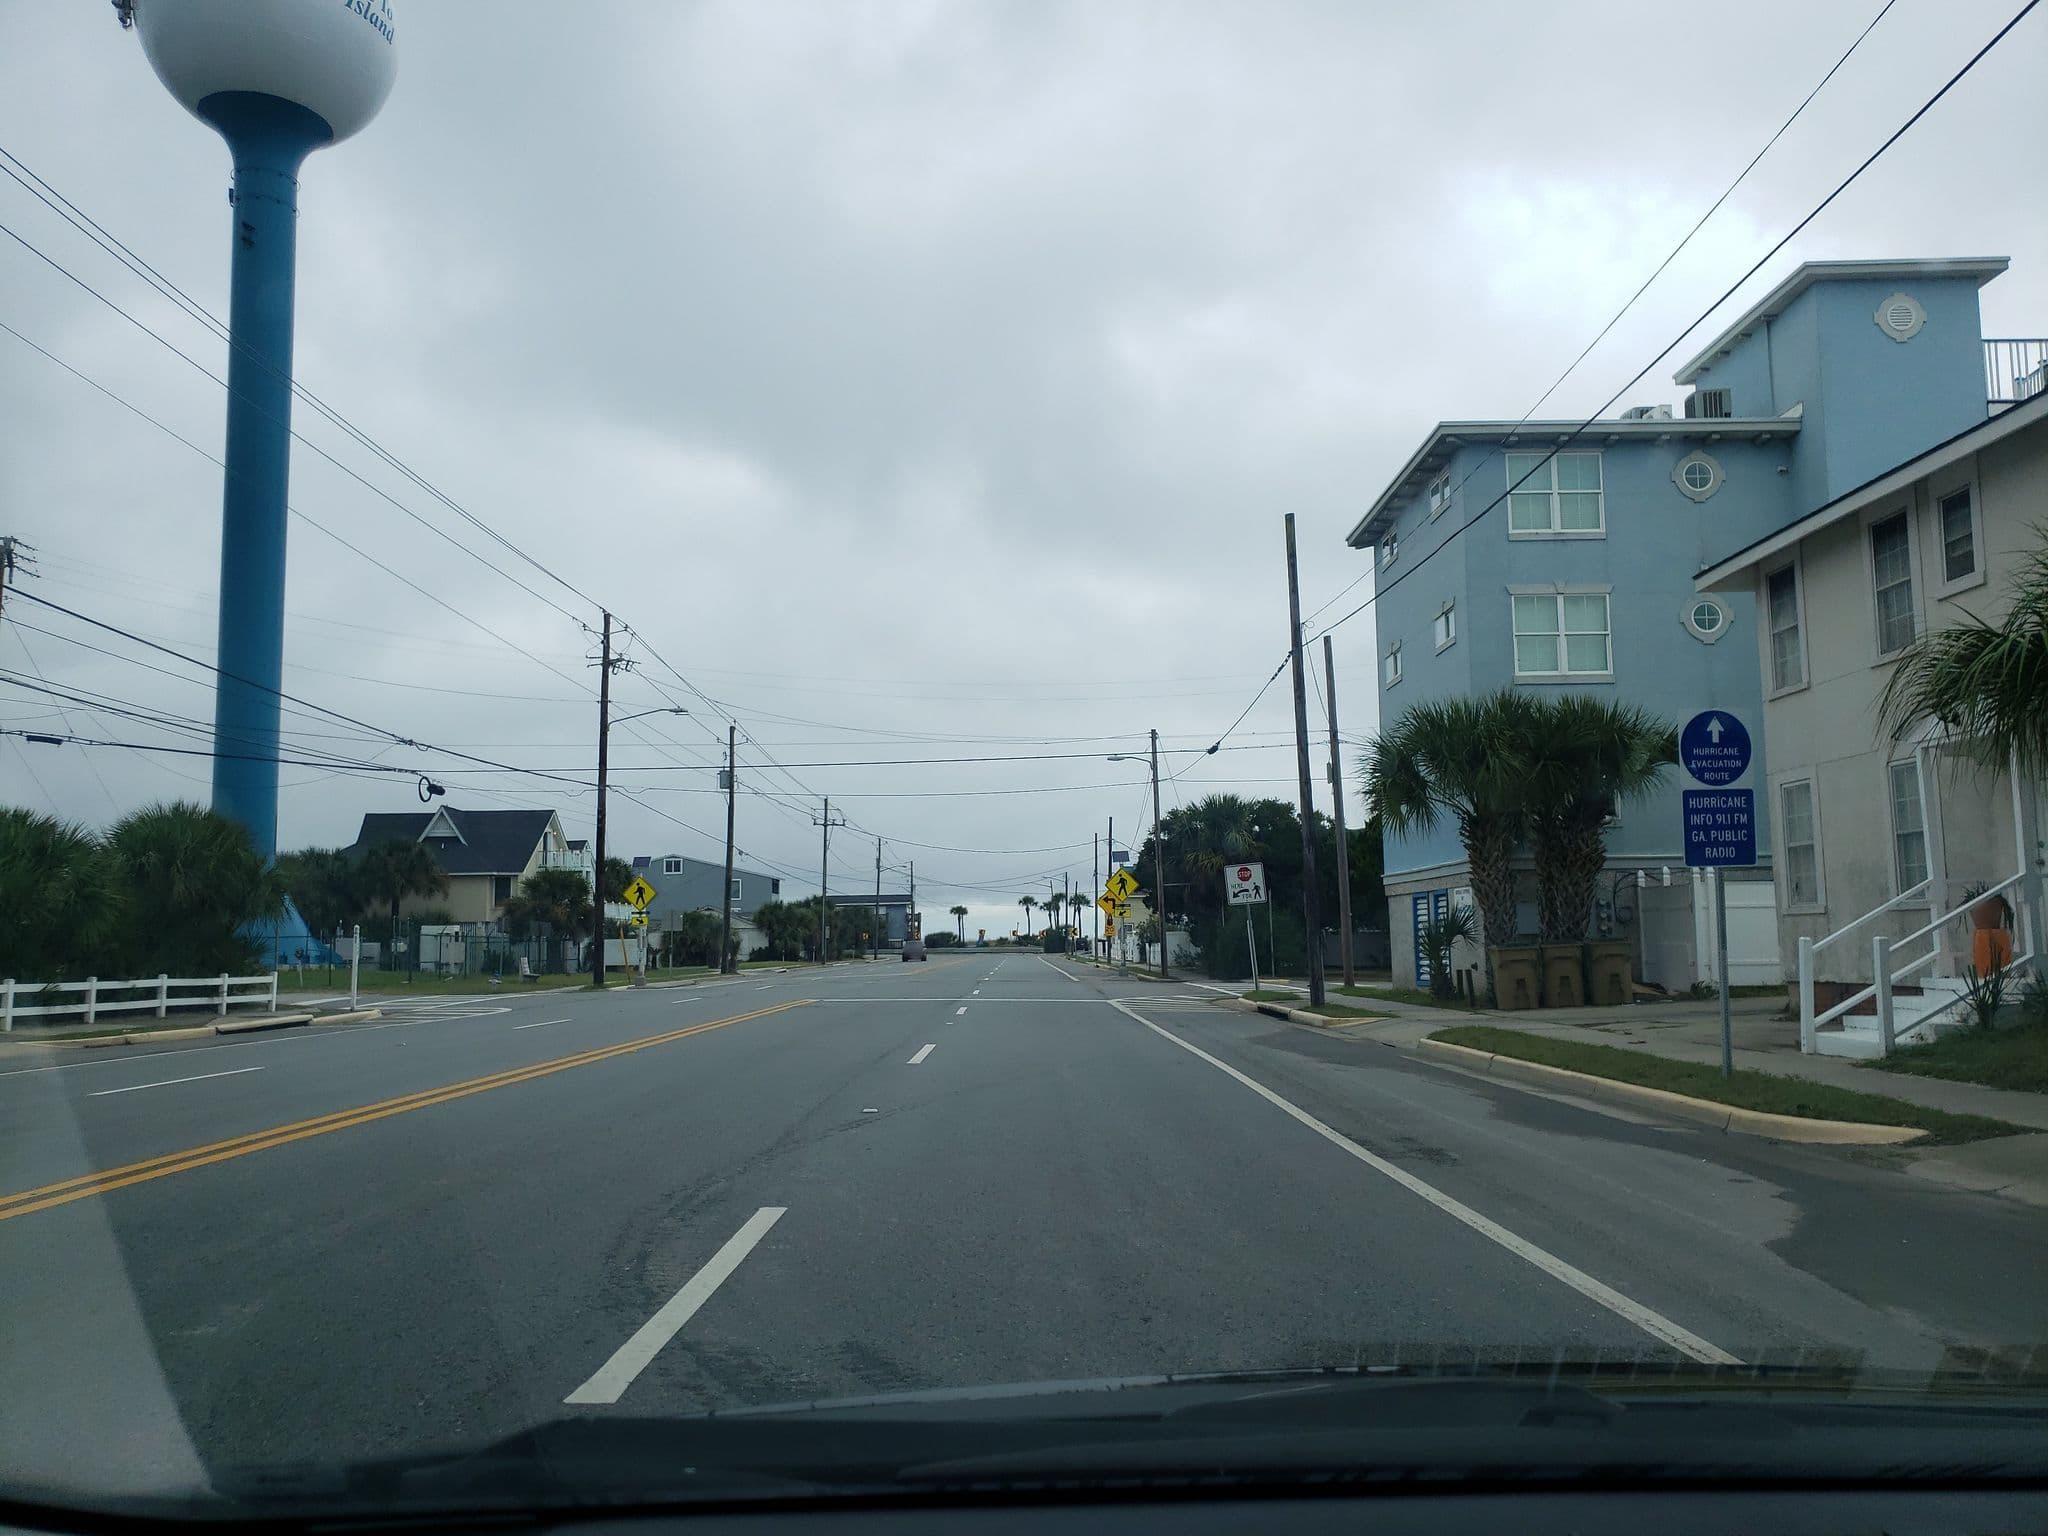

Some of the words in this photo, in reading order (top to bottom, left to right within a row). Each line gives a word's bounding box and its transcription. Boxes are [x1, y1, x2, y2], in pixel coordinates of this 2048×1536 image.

[1693, 747, 1739, 756] HURRICANE
[1692, 759, 1742, 768] EVACUATION
[1704, 772, 1730, 781] ROUTE
[1689, 796, 1747, 809] HURRICANE
[1690, 814, 1713, 826] INFO
[1716, 813, 1731, 825] 91.1
[1734, 813, 1748, 825] FM
[1692, 830, 1707, 842] GA.
[1711, 830, 1748, 842] PUBLIC
[1705, 847, 1736, 859] RADIO
